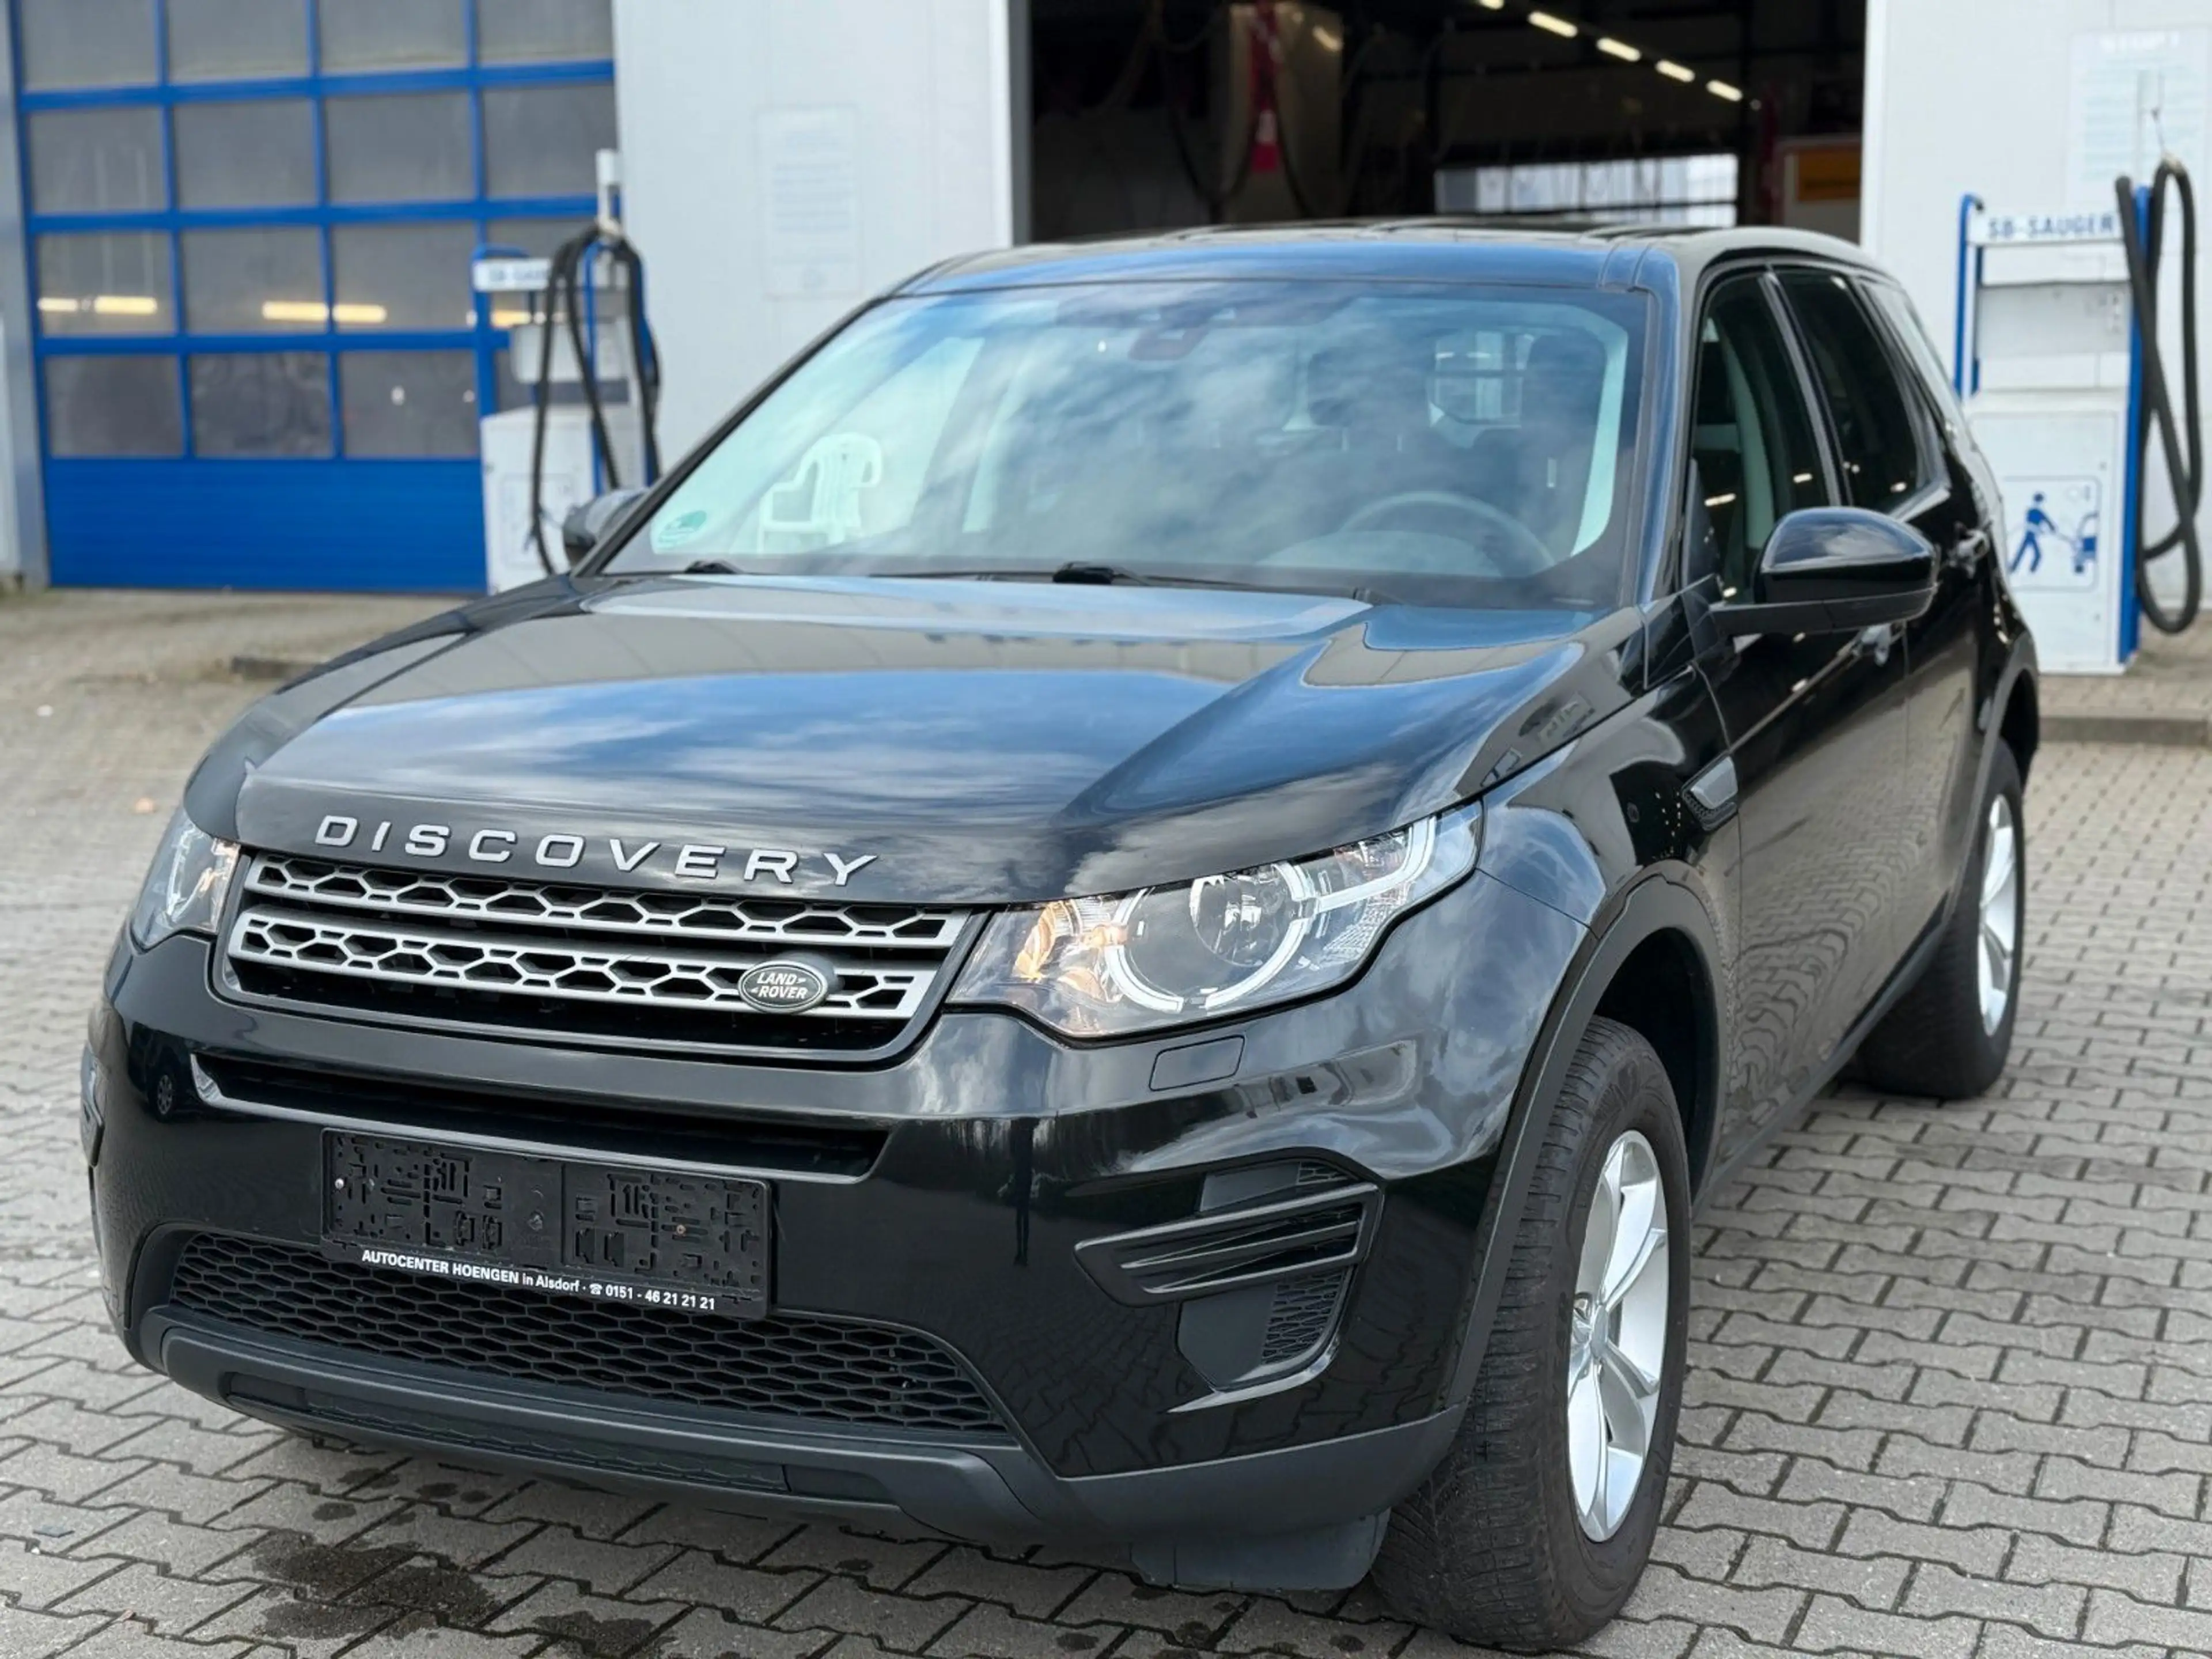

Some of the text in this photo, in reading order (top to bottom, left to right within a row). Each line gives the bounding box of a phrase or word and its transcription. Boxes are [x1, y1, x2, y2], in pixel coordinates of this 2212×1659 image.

[315, 815, 877, 886] DISCOVERY
[757, 972, 797, 985] LAND
[758, 986, 808, 999] ROVER
[362, 1249, 449, 1274] AUTOCENTER
[452, 1263, 519, 1283] HOENGEN
[522, 1274, 533, 1286] in
[536, 1275, 580, 1292] Alsdorf
[605, 1285, 633, 1299] 0151
[645, 1290, 660, 1302] 46
[664, 1292, 677, 1306] 21
[681, 1294, 696, 1308] 21
[699, 1297, 715, 1310] 21
